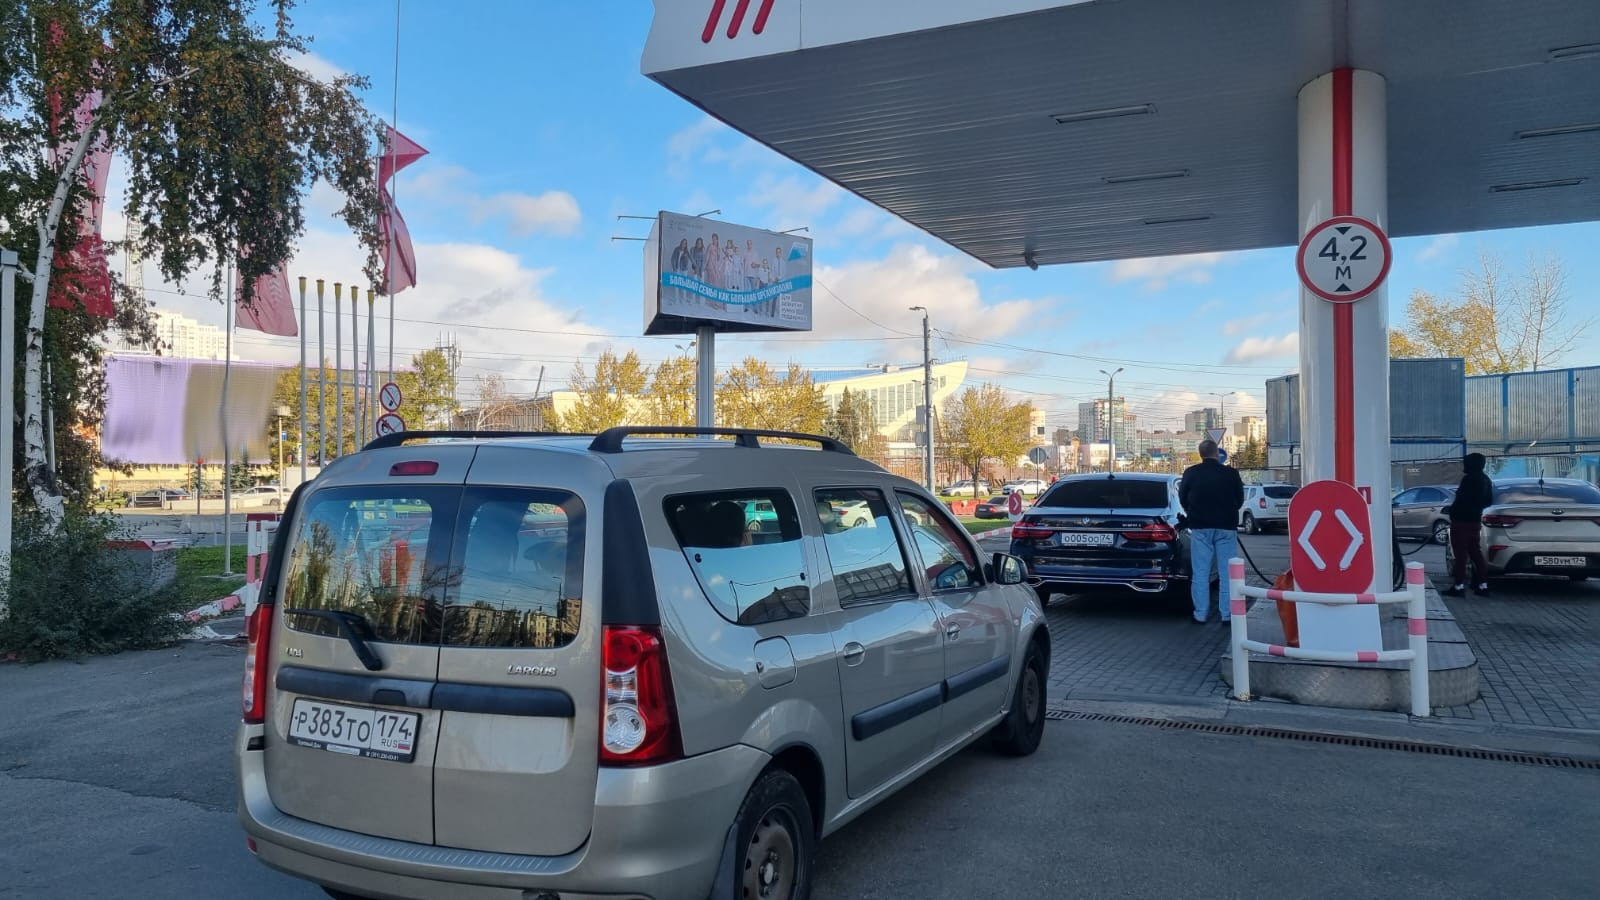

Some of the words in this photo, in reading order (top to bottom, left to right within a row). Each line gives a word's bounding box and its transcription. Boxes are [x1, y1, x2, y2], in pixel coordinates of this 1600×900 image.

[1318, 235, 1367, 265] 4,2
[1335, 266, 1352, 280] М
[670, 275, 698, 291] БОЛЬШАЯ
[698, 284, 718, 298] СЕМЬЯ
[718, 291, 729, 302] КАК
[731, 292, 757, 303] БОЛЬШАЯ
[507, 665, 557, 677] LARGUS
[296, 707, 371, 742] Р383ТО
[377, 714, 409, 740] 174
[381, 739, 398, 749] RUS
